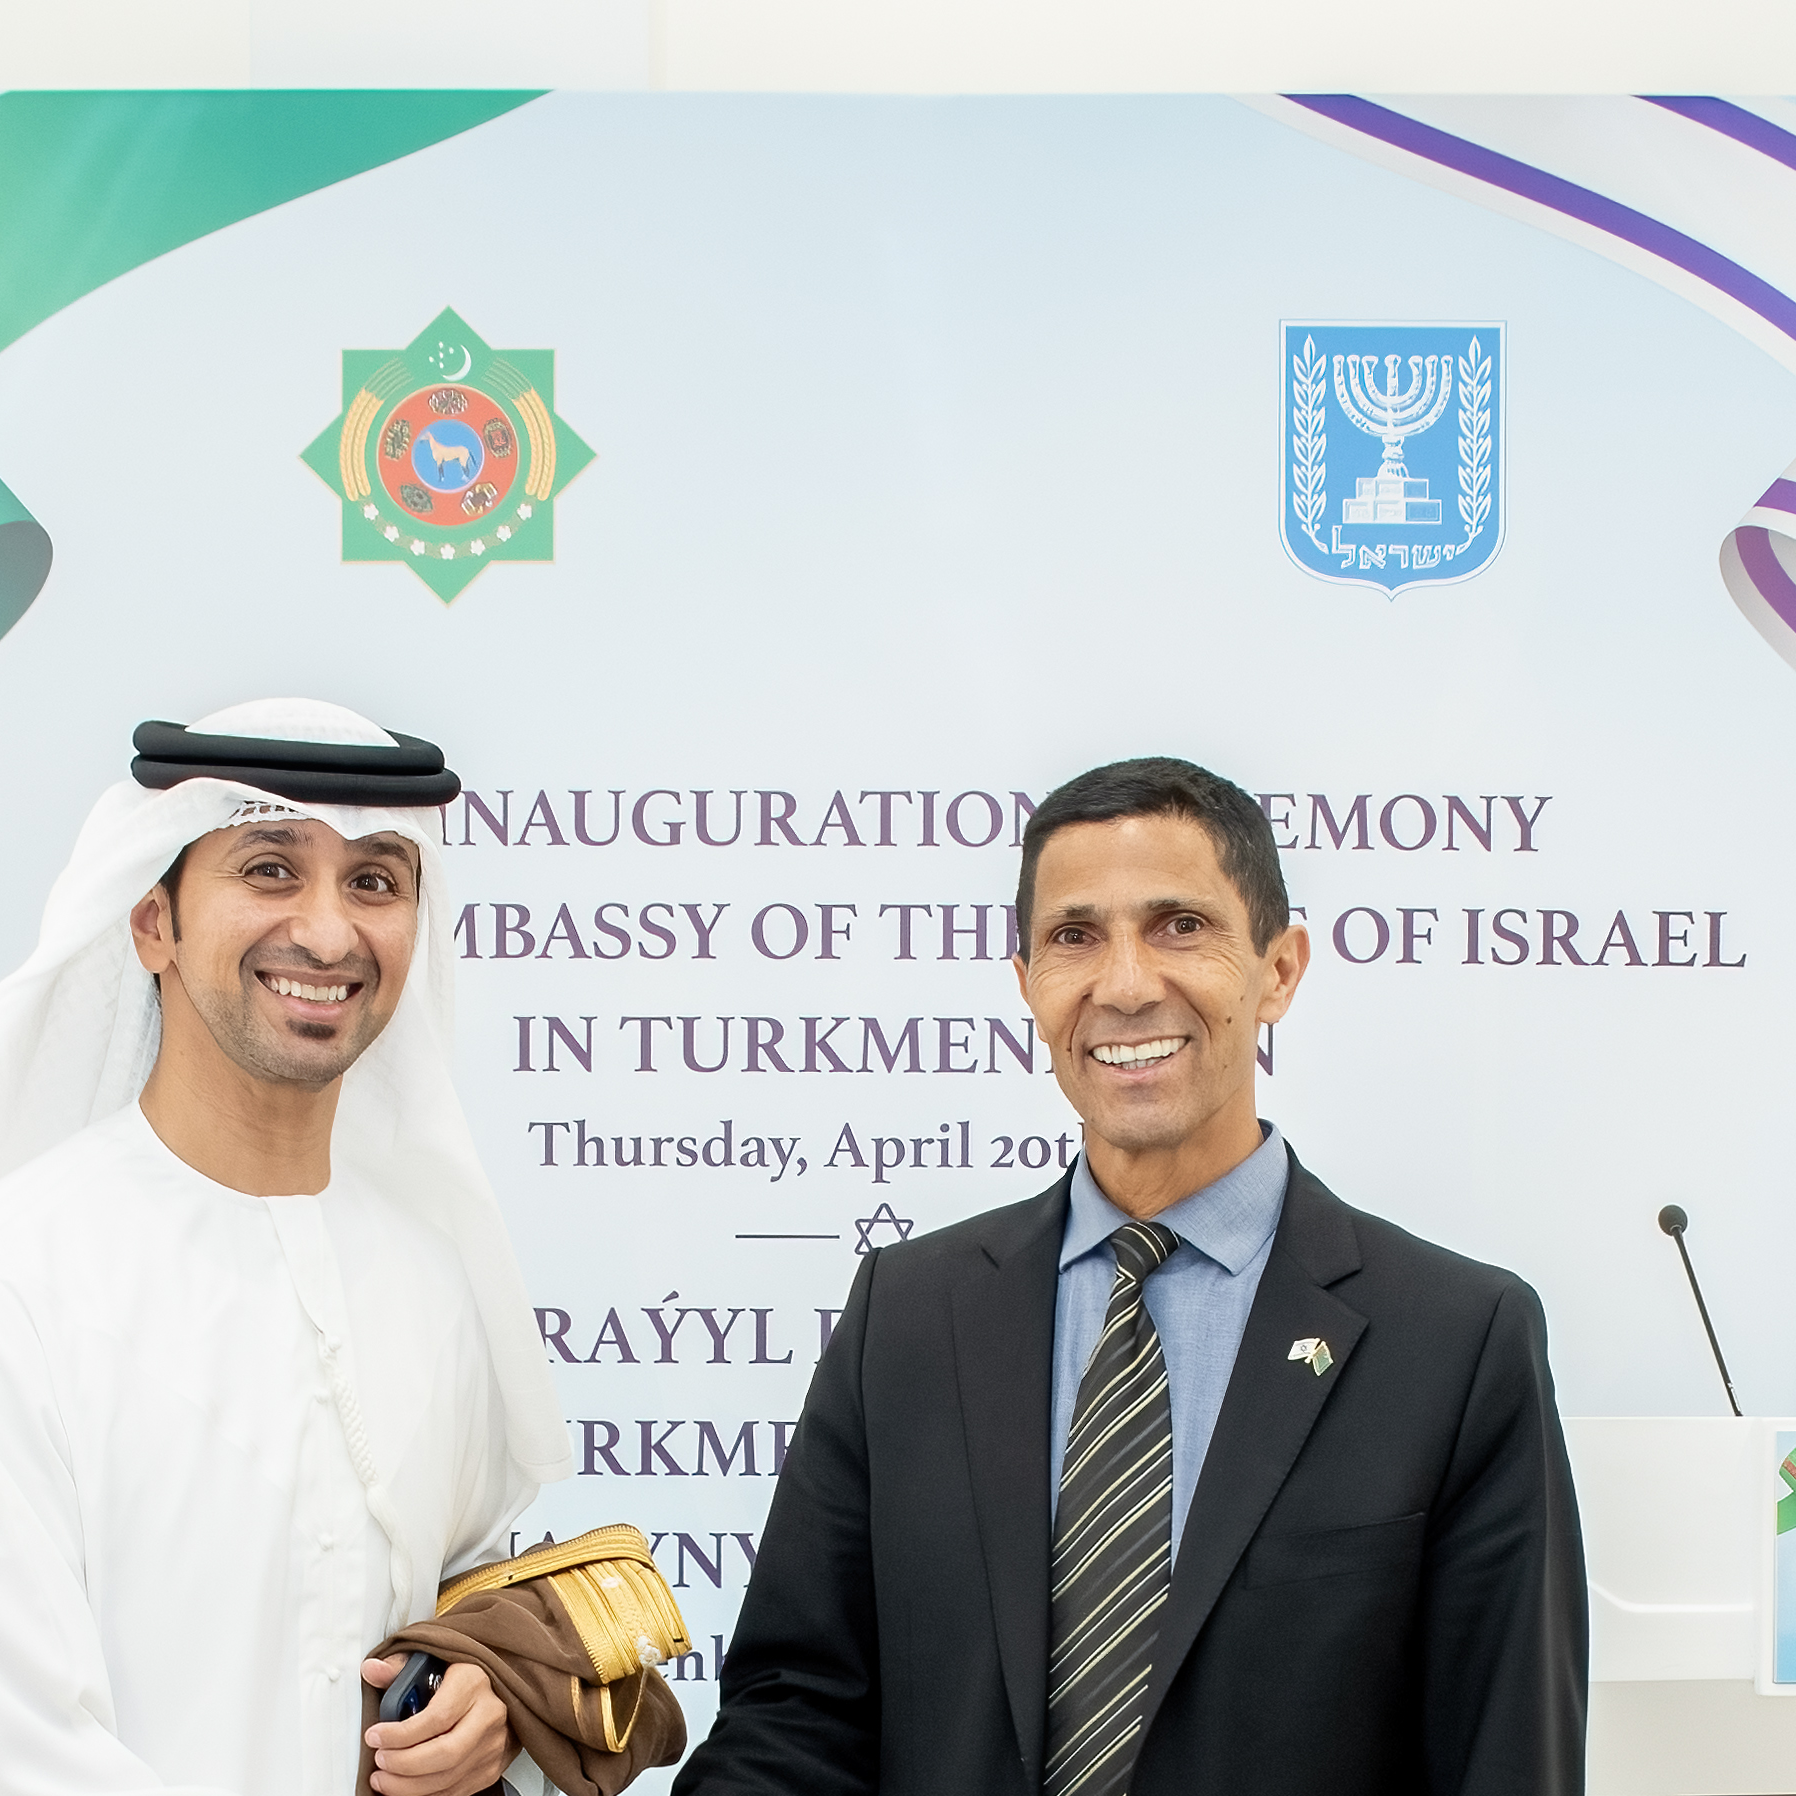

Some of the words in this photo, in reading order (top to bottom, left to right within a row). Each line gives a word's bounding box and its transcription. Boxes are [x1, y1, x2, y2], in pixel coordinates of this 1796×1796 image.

[1331, 524, 1456, 570] ישראל
[442, 789, 1052, 847] NAUGURATIO
[1255, 793, 1553, 852] EMONY
[751, 903, 858, 960] OF
[1332, 906, 1440, 965] OF
[1461, 908, 1747, 968] ISRAEL
[512, 1016, 598, 1073] IN
[619, 1016, 1274, 1076] TURKMEN
[528, 1119, 808, 1183] Thursday,
[823, 1120, 974, 1184] April
[991, 1122, 1085, 1170] 20t
[533, 1290, 794, 1364] RAÝYL
